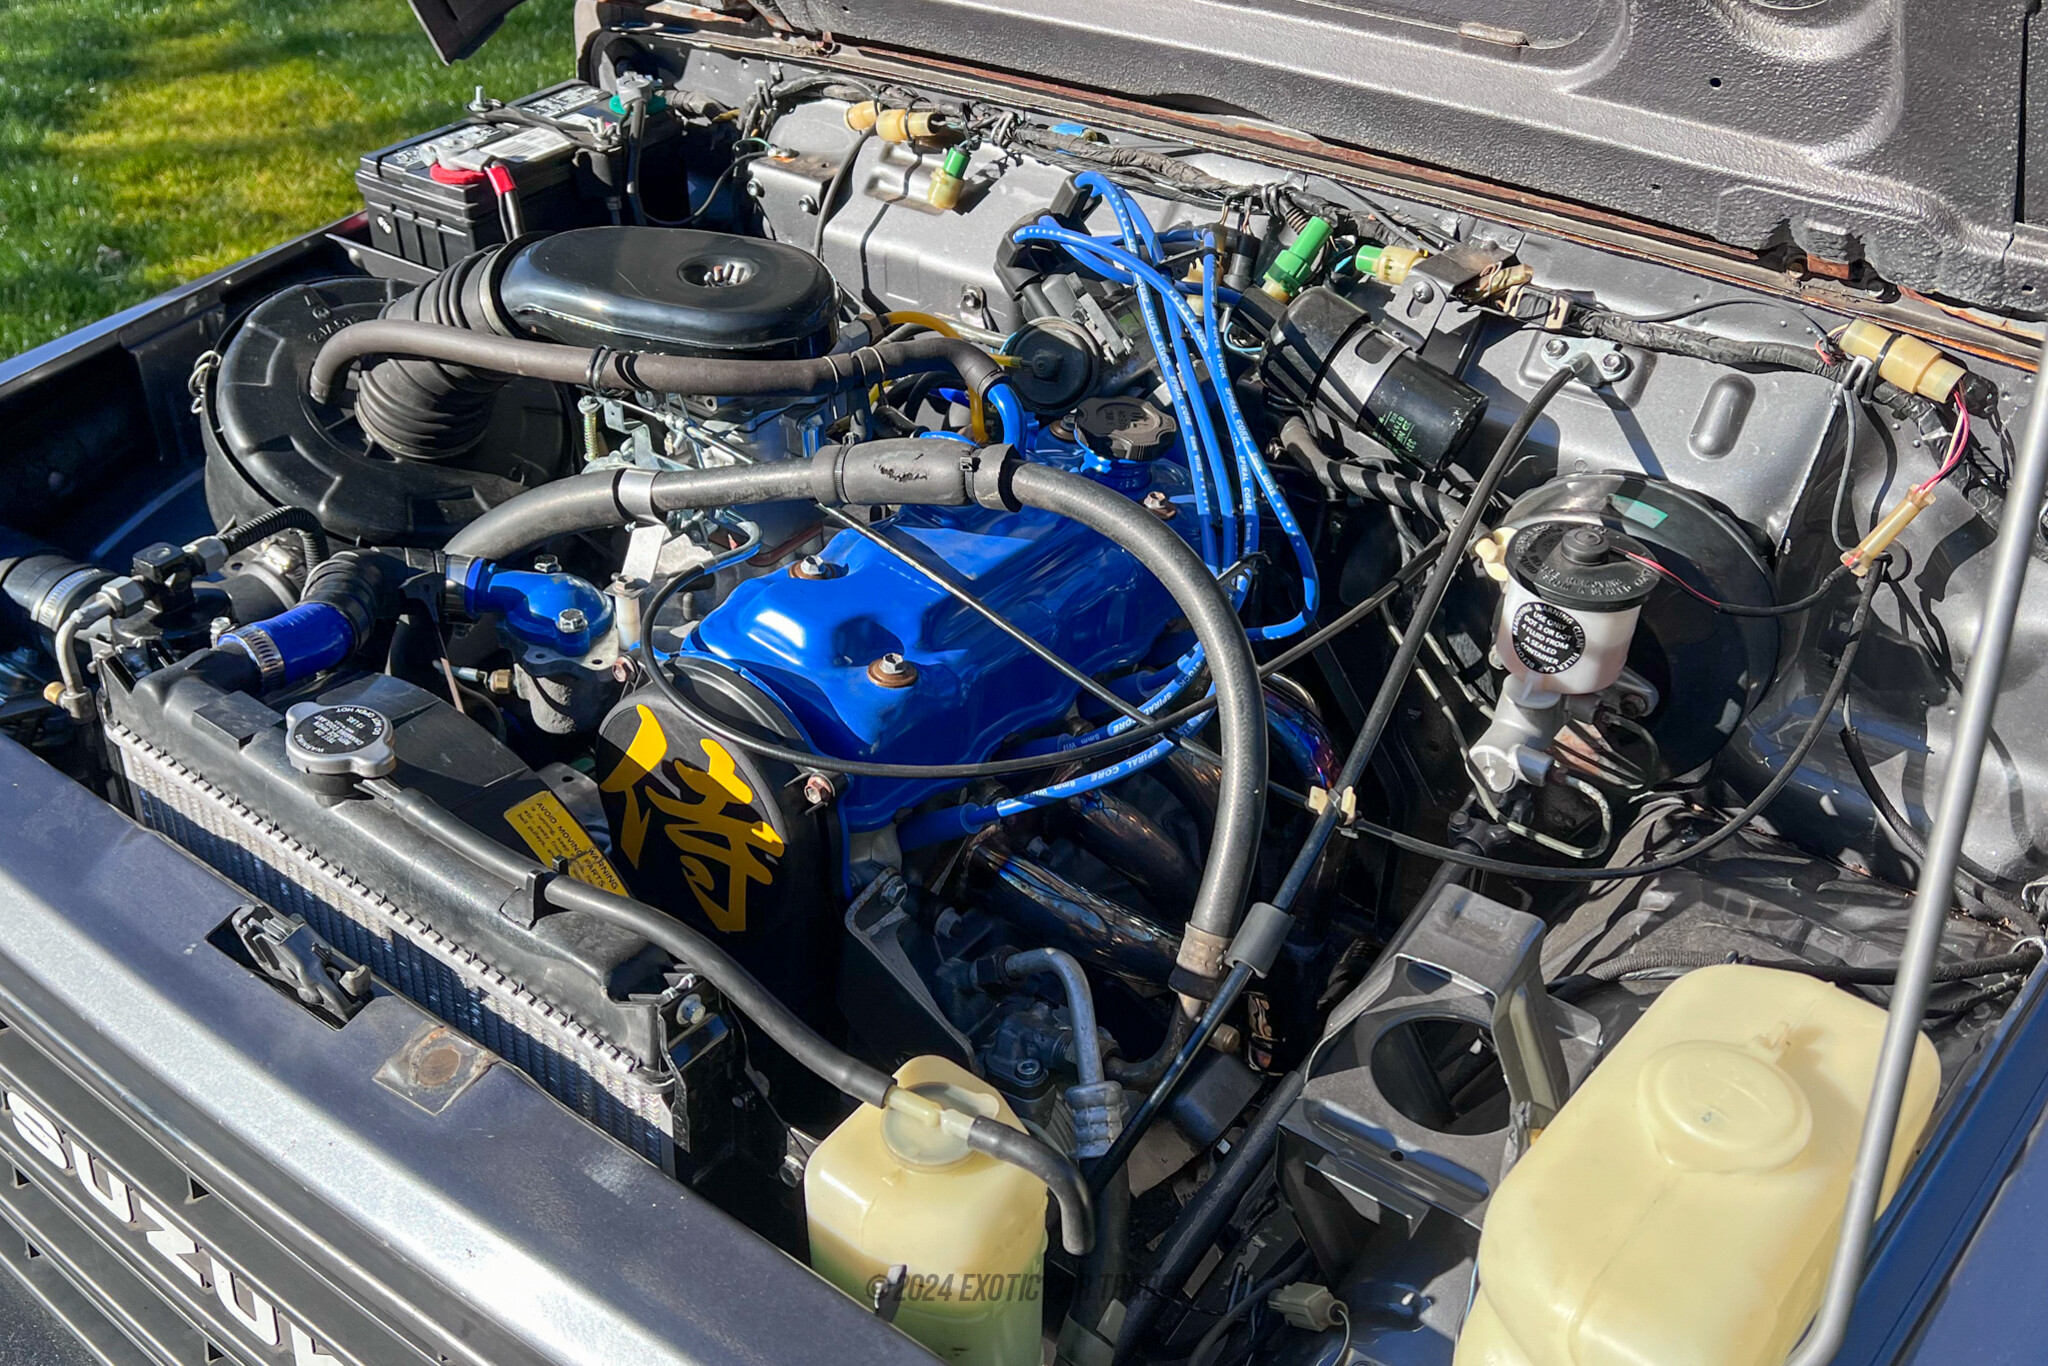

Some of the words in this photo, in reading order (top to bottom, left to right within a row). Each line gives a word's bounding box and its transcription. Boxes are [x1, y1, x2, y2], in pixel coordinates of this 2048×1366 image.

[1147, 308, 1160, 336] SUPER
[1156, 340, 1172, 368] STOCK
[1169, 375, 1184, 400] SPIRAL
[1180, 405, 1193, 426] CORE
[1194, 454, 1203, 472] WIRE
[1216, 353, 1227, 379] STOCK
[1225, 387, 1239, 414] SPIRAL
[1236, 419, 1252, 442] CORE
[1262, 474, 1278, 497] WIRE
[1238, 455, 1250, 482] SPIRAL
[1243, 487, 1253, 511] CORE
[1533, 612, 1547, 623] USE
[1547, 620, 1567, 631] ONLY
[1534, 603, 1574, 625] WARNING
[1524, 615, 1538, 627] DOT
[1543, 627, 1555, 636] OR
[1555, 632, 1572, 641] DOT
[1525, 627, 1546, 640] FLUID
[1545, 638, 1569, 650] FROM
[1572, 625, 1584, 648] CLEAN
[1515, 642, 1535, 669] BEFORE
[1520, 642, 1560, 665] CONTAINER
[1530, 639, 1557, 655] SEALED
[1557, 652, 1580, 671] FILLER
[355, 708, 375, 719] OPEN
[1143, 691, 1173, 716] SPIRAL
[295, 733, 325, 753] WARNING
[1080, 733, 1101, 744] 8mm
[1126, 748, 1160, 768] SPIRAL
[1054, 780, 1076, 791] 8mm
[1091, 766, 1120, 782] CORE
[599, 703, 785, 933] 侍
[536, 802, 558, 824] AVOID
[584, 858, 606, 888] PARTS
[589, 847, 619, 890] WARNING
